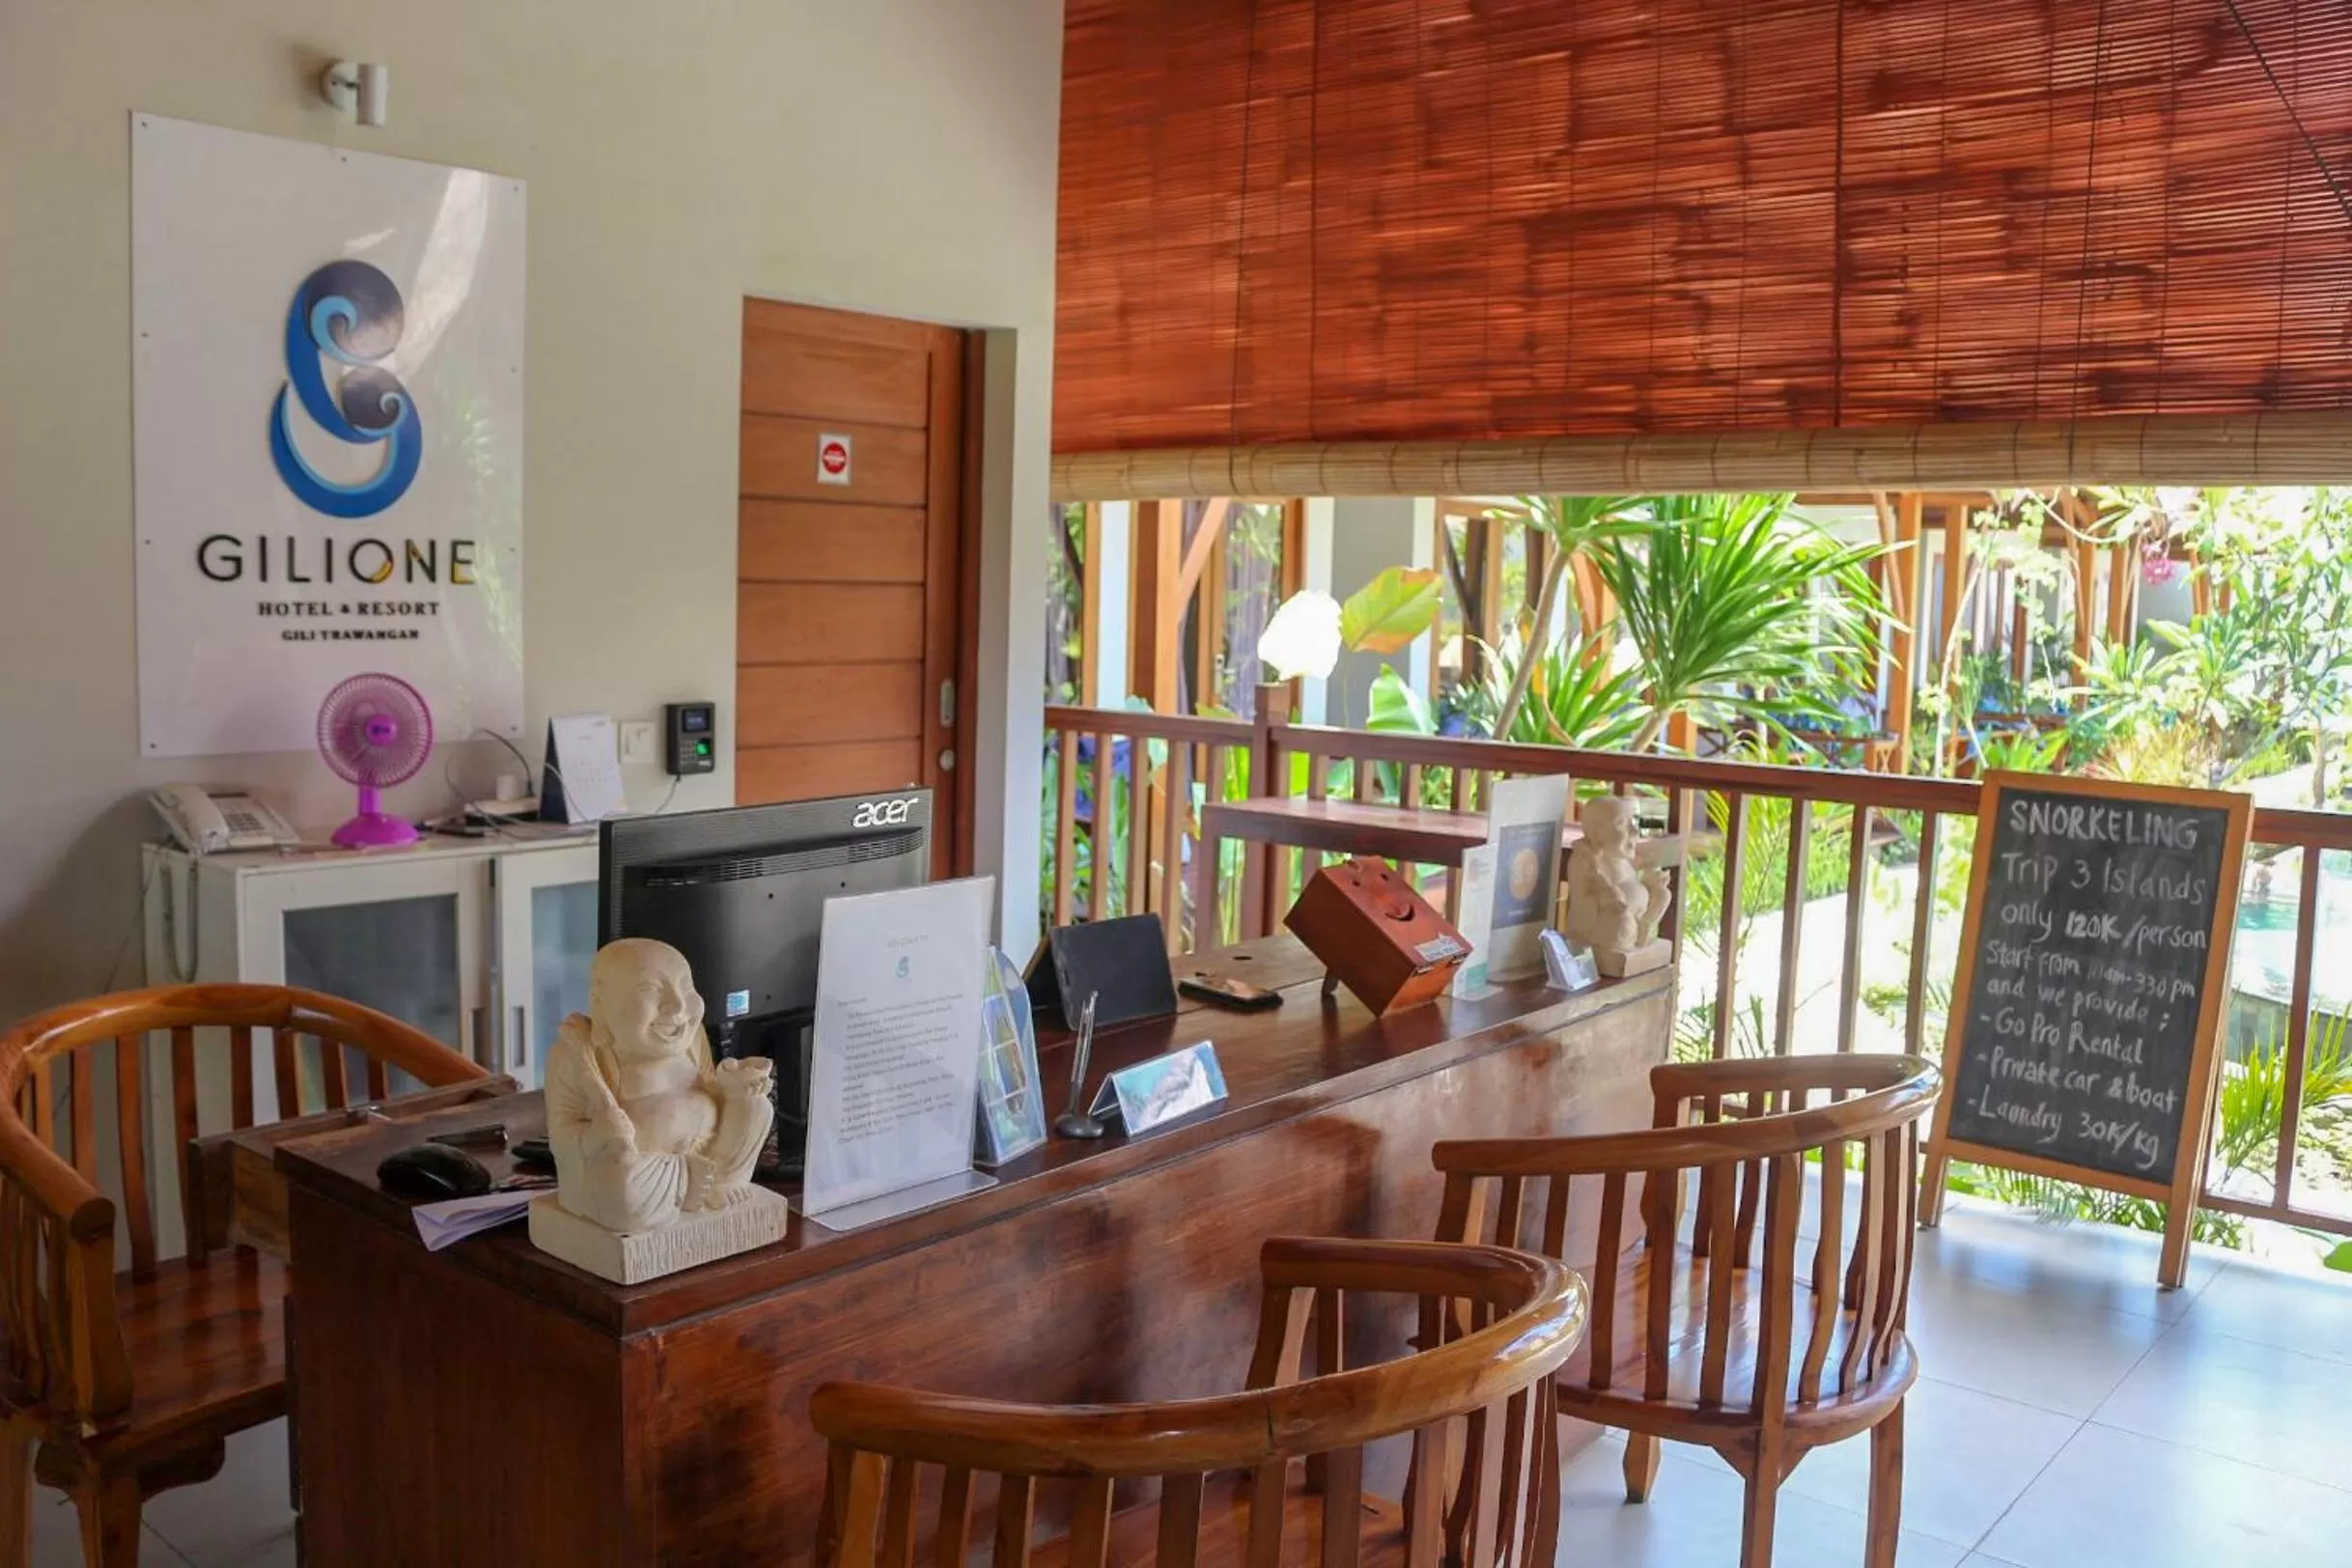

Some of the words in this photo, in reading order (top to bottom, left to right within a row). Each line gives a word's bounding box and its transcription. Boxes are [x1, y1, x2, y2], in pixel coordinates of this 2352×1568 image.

[197, 534, 476, 584] GILIONE
[259, 602, 333, 616] HOTEL
[357, 602, 440, 616] RESORT
[281, 630, 316, 640] GILI
[321, 629, 419, 641] TRAWANGAN
[853, 797, 919, 827] acer
[2010, 799, 2198, 850] SNORKELING
[2002, 852, 2058, 893] Trip
[2071, 859, 2091, 889] 3
[2103, 856, 2206, 906] Islands
[2001, 900, 2052, 943] only
[2065, 910, 2123, 943] 120K
[2038, 951, 2081, 977] from
[1986, 975, 2025, 997] and
[2038, 984, 2066, 1006] we
[2075, 991, 2149, 1023] provide
[2067, 1021, 2144, 1065] Rental
[1990, 1045, 2060, 1088] Private
[2063, 1069, 2102, 1095] car
[2125, 1071, 2178, 1113] boat
[1978, 1082, 2062, 1144] Laundry
